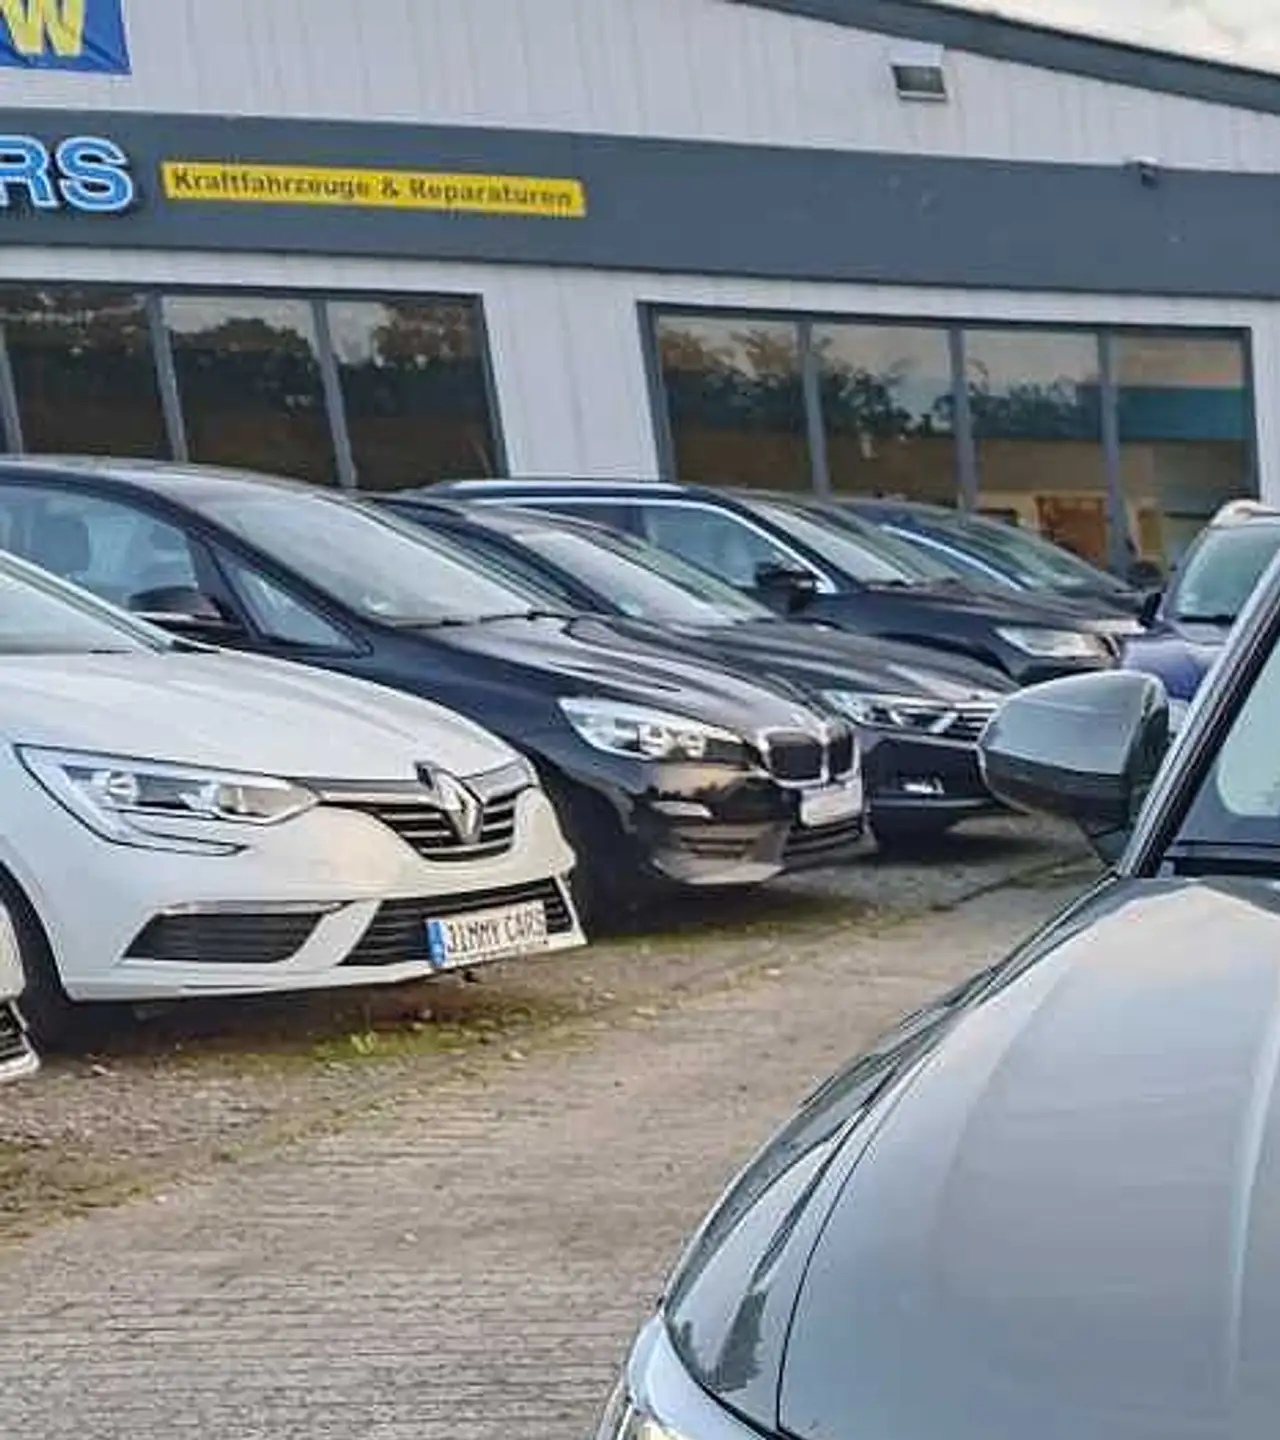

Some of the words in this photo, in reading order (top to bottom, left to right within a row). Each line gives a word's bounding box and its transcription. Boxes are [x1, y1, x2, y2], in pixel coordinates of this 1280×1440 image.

[172, 167, 369, 200] Kraftfahrzeuge
[380, 175, 399, 199] &
[409, 178, 573, 208] Reparaturen
